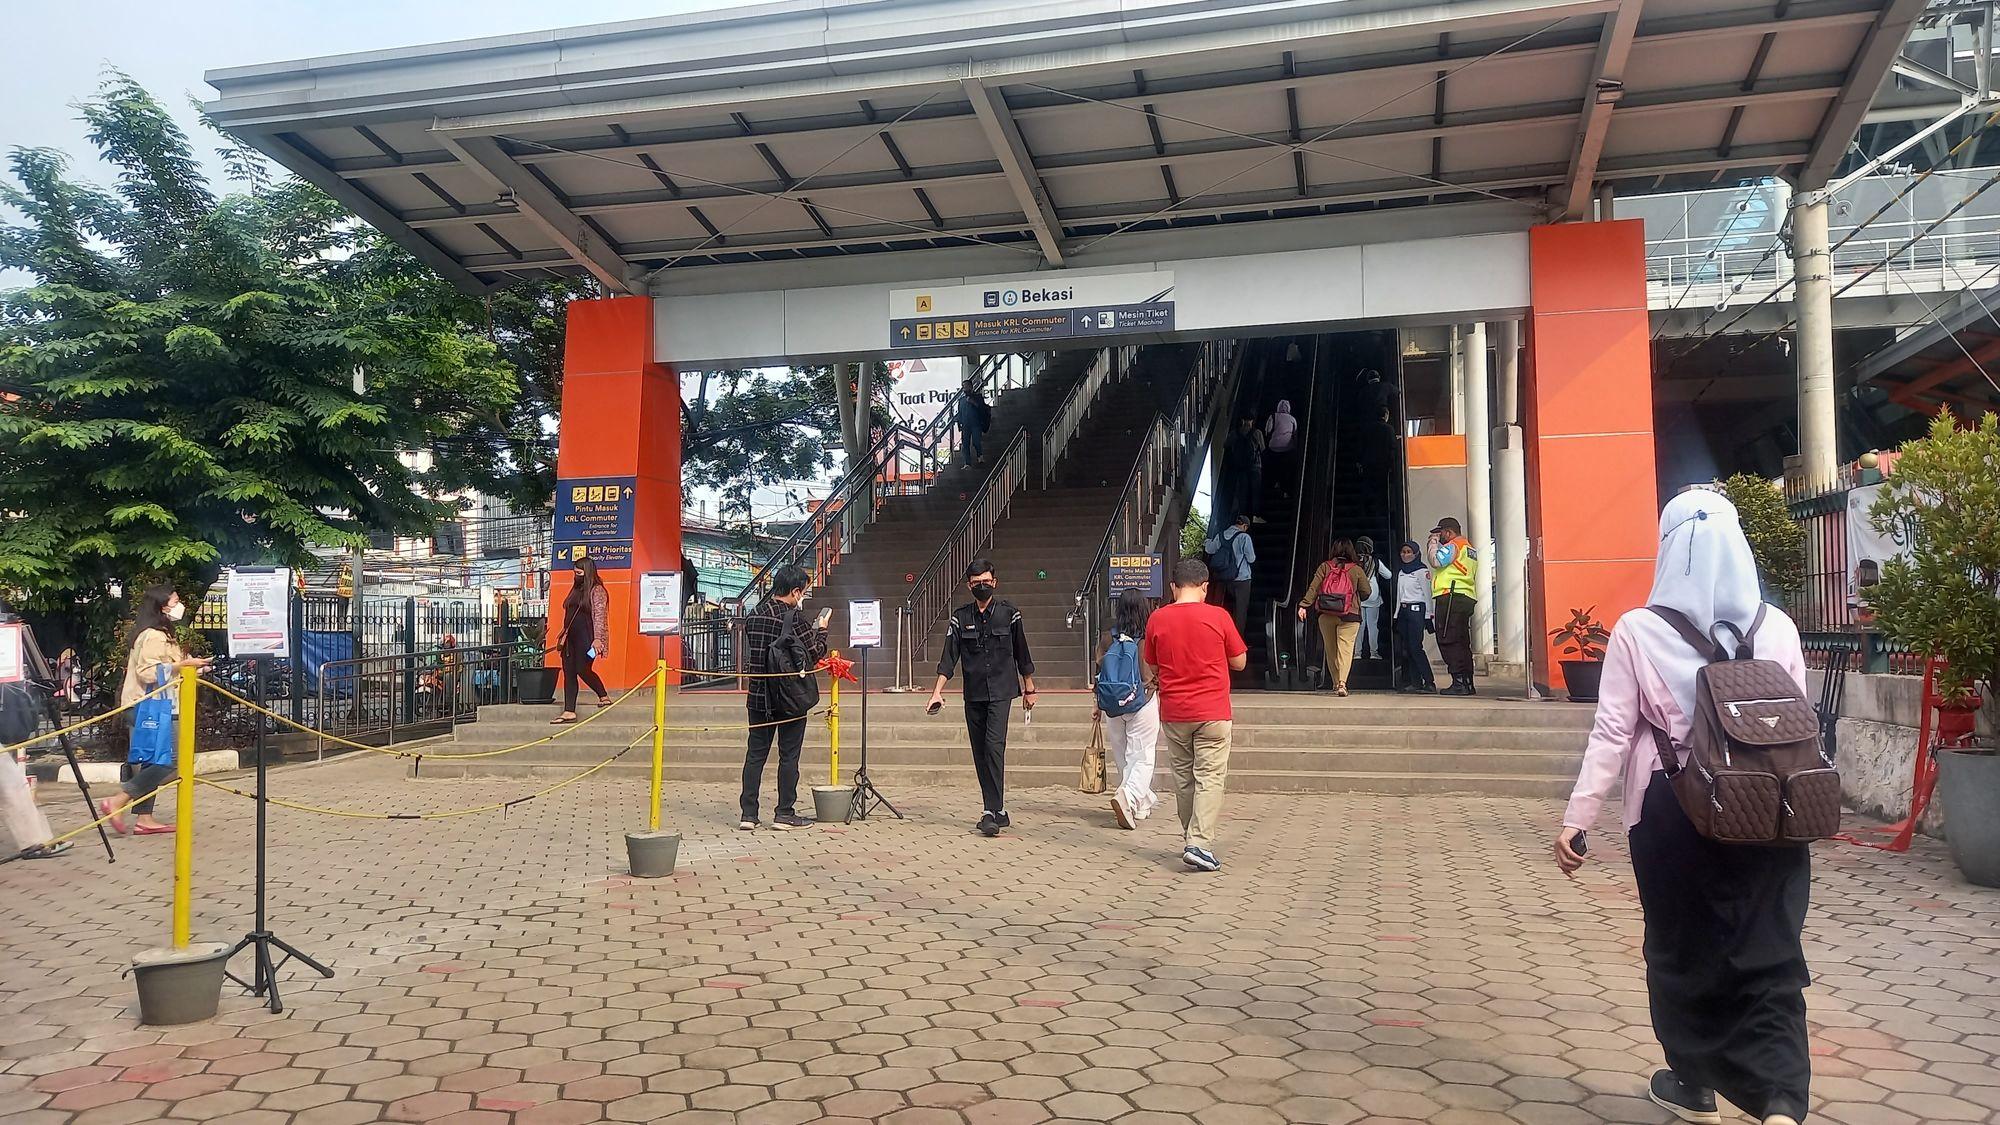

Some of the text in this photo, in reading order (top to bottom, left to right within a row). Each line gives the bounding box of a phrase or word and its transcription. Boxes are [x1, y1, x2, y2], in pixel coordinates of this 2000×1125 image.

[1022, 286, 1073, 303] Bekasi
[920, 300, 928, 308] A
[1118, 308, 1168, 320] Mesin Tiket
[974, 316, 1066, 328] Masuk KRL Commuter
[897, 392, 926, 405] Taat
